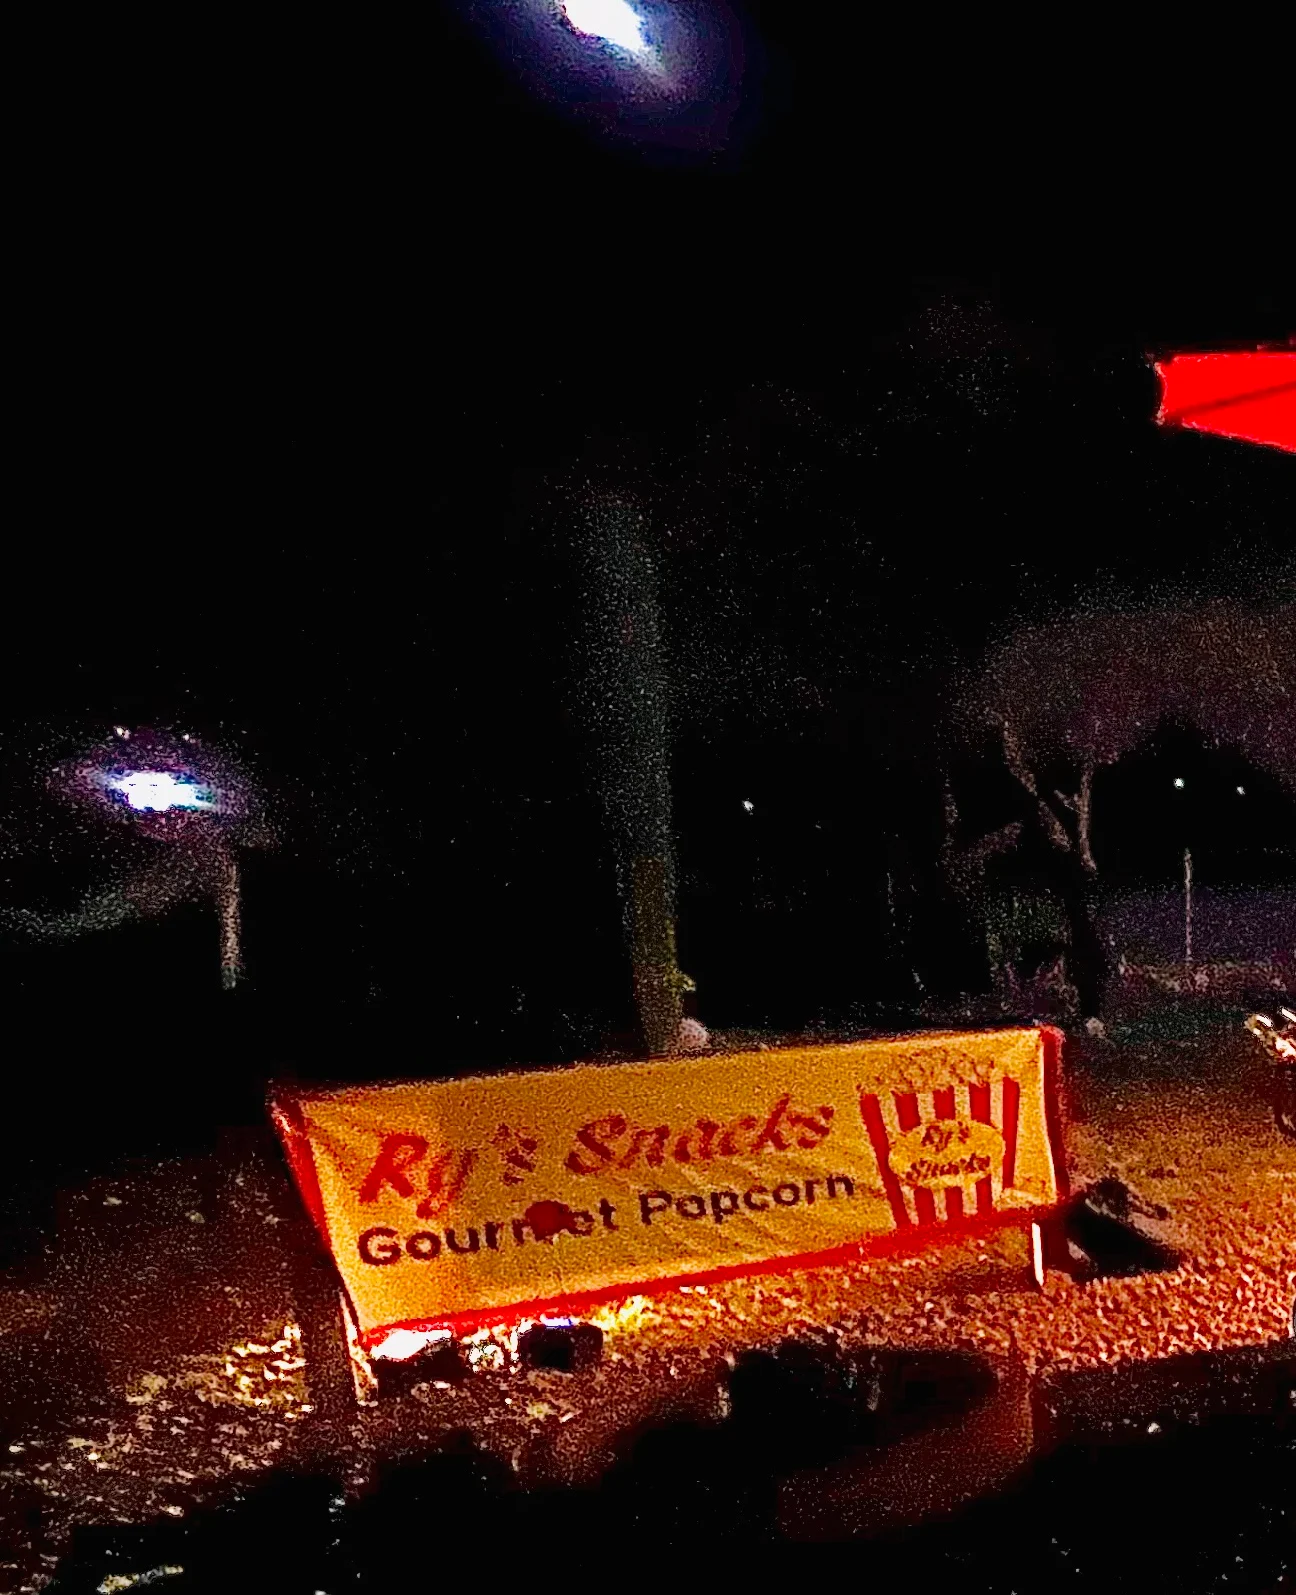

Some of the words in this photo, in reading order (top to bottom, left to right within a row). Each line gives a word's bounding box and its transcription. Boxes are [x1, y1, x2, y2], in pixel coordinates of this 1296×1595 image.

[359, 1122, 538, 1220] Ry's
[563, 1093, 835, 1175] Snacks
[638, 1173, 856, 1225] Popcorn
